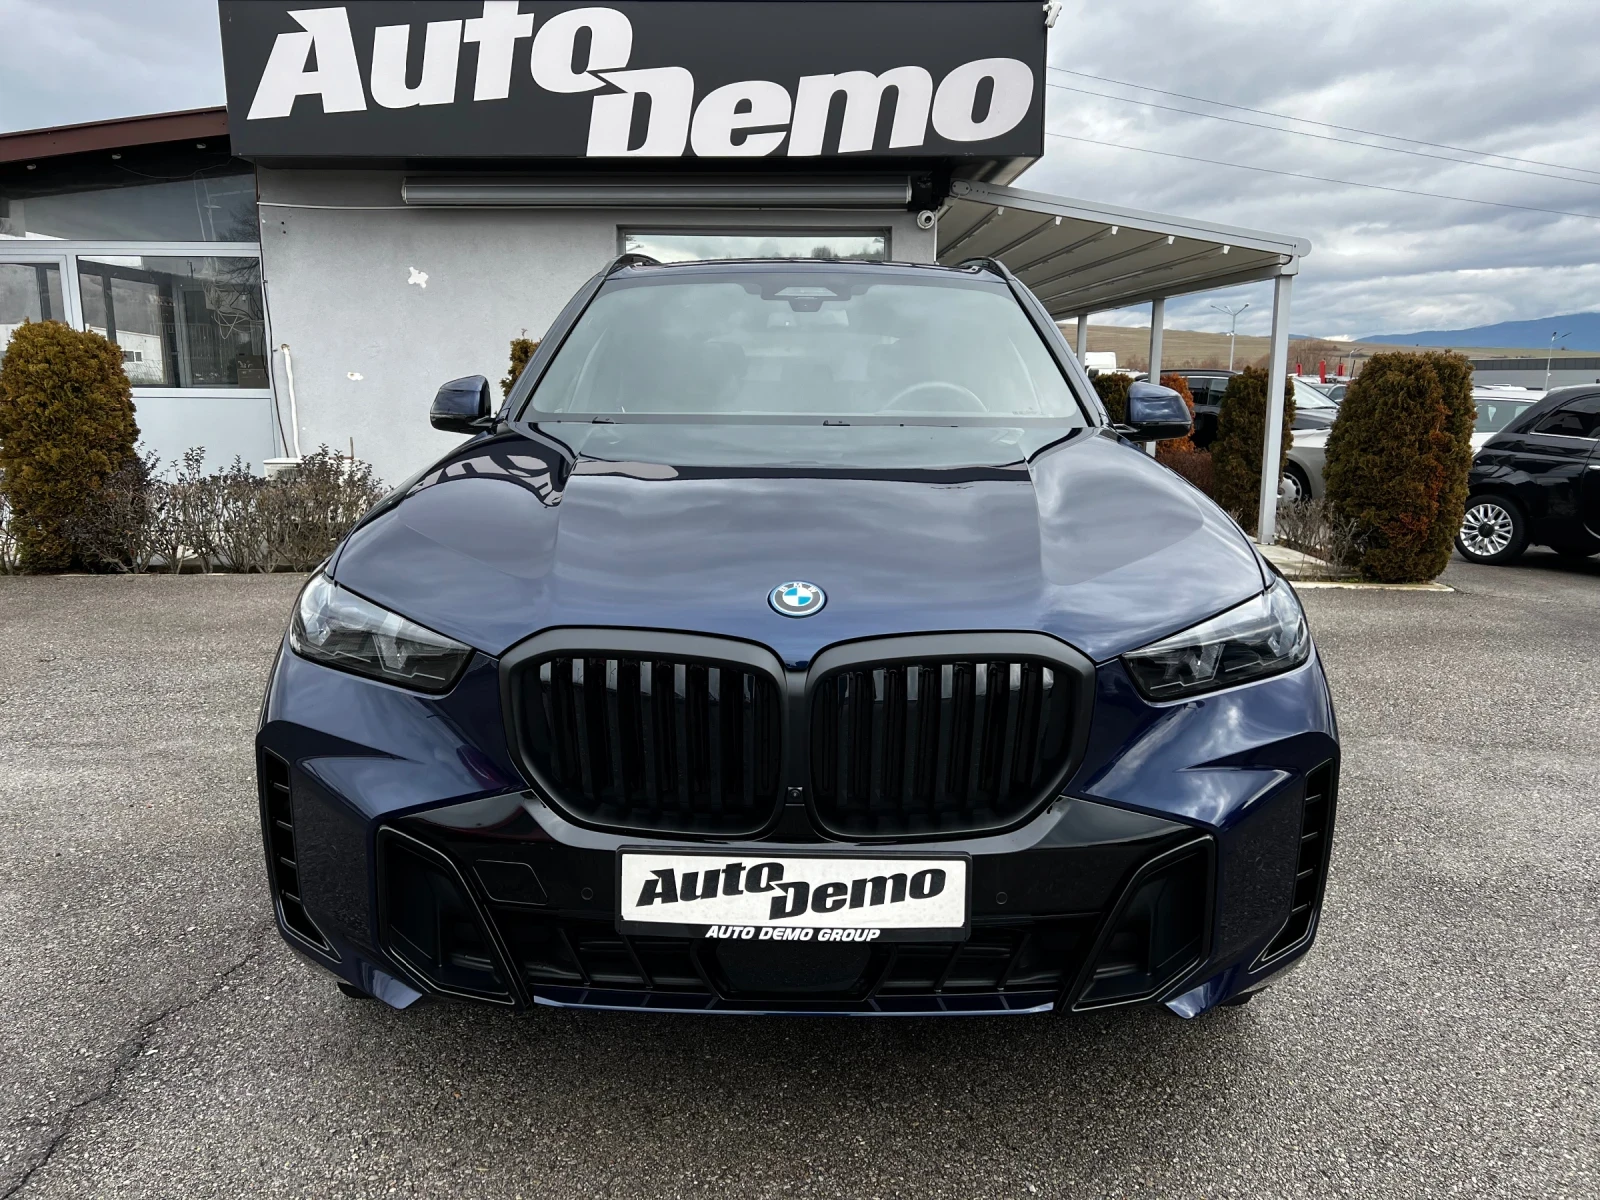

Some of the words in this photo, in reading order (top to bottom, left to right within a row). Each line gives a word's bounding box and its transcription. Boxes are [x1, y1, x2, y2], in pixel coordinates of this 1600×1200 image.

[247, 1, 632, 120] Auto
[586, 58, 1034, 157] Demo
[779, 582, 818, 593] BMW
[636, 862, 785, 907] Auto
[769, 868, 947, 921] Demo
[705, 925, 756, 940] AUTO
[758, 926, 814, 942] DEMO
[817, 928, 881, 942] GROUP
